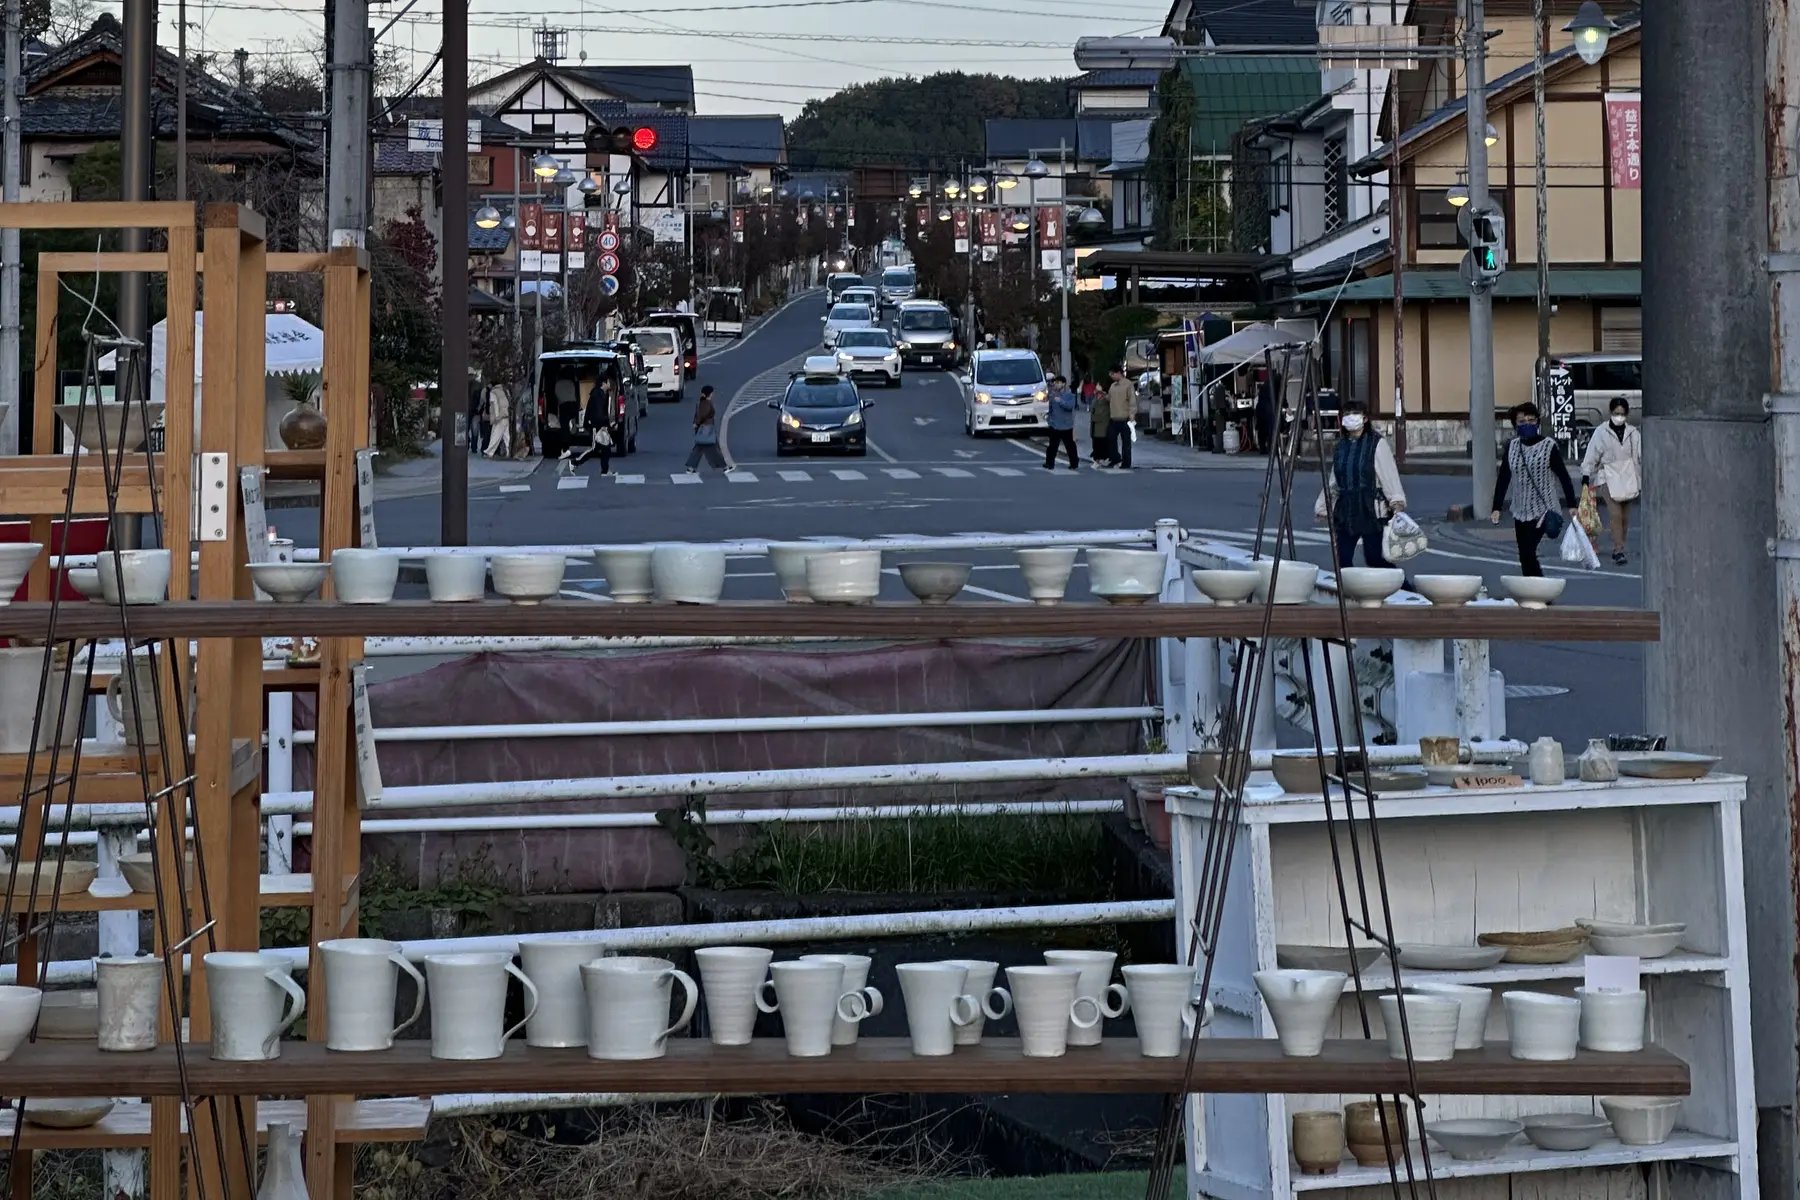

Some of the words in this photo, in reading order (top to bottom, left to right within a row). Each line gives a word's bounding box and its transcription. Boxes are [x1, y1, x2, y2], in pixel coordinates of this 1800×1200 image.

[1624, 108, 1640, 181] 益子本通り
[603, 237, 614, 246] 40
